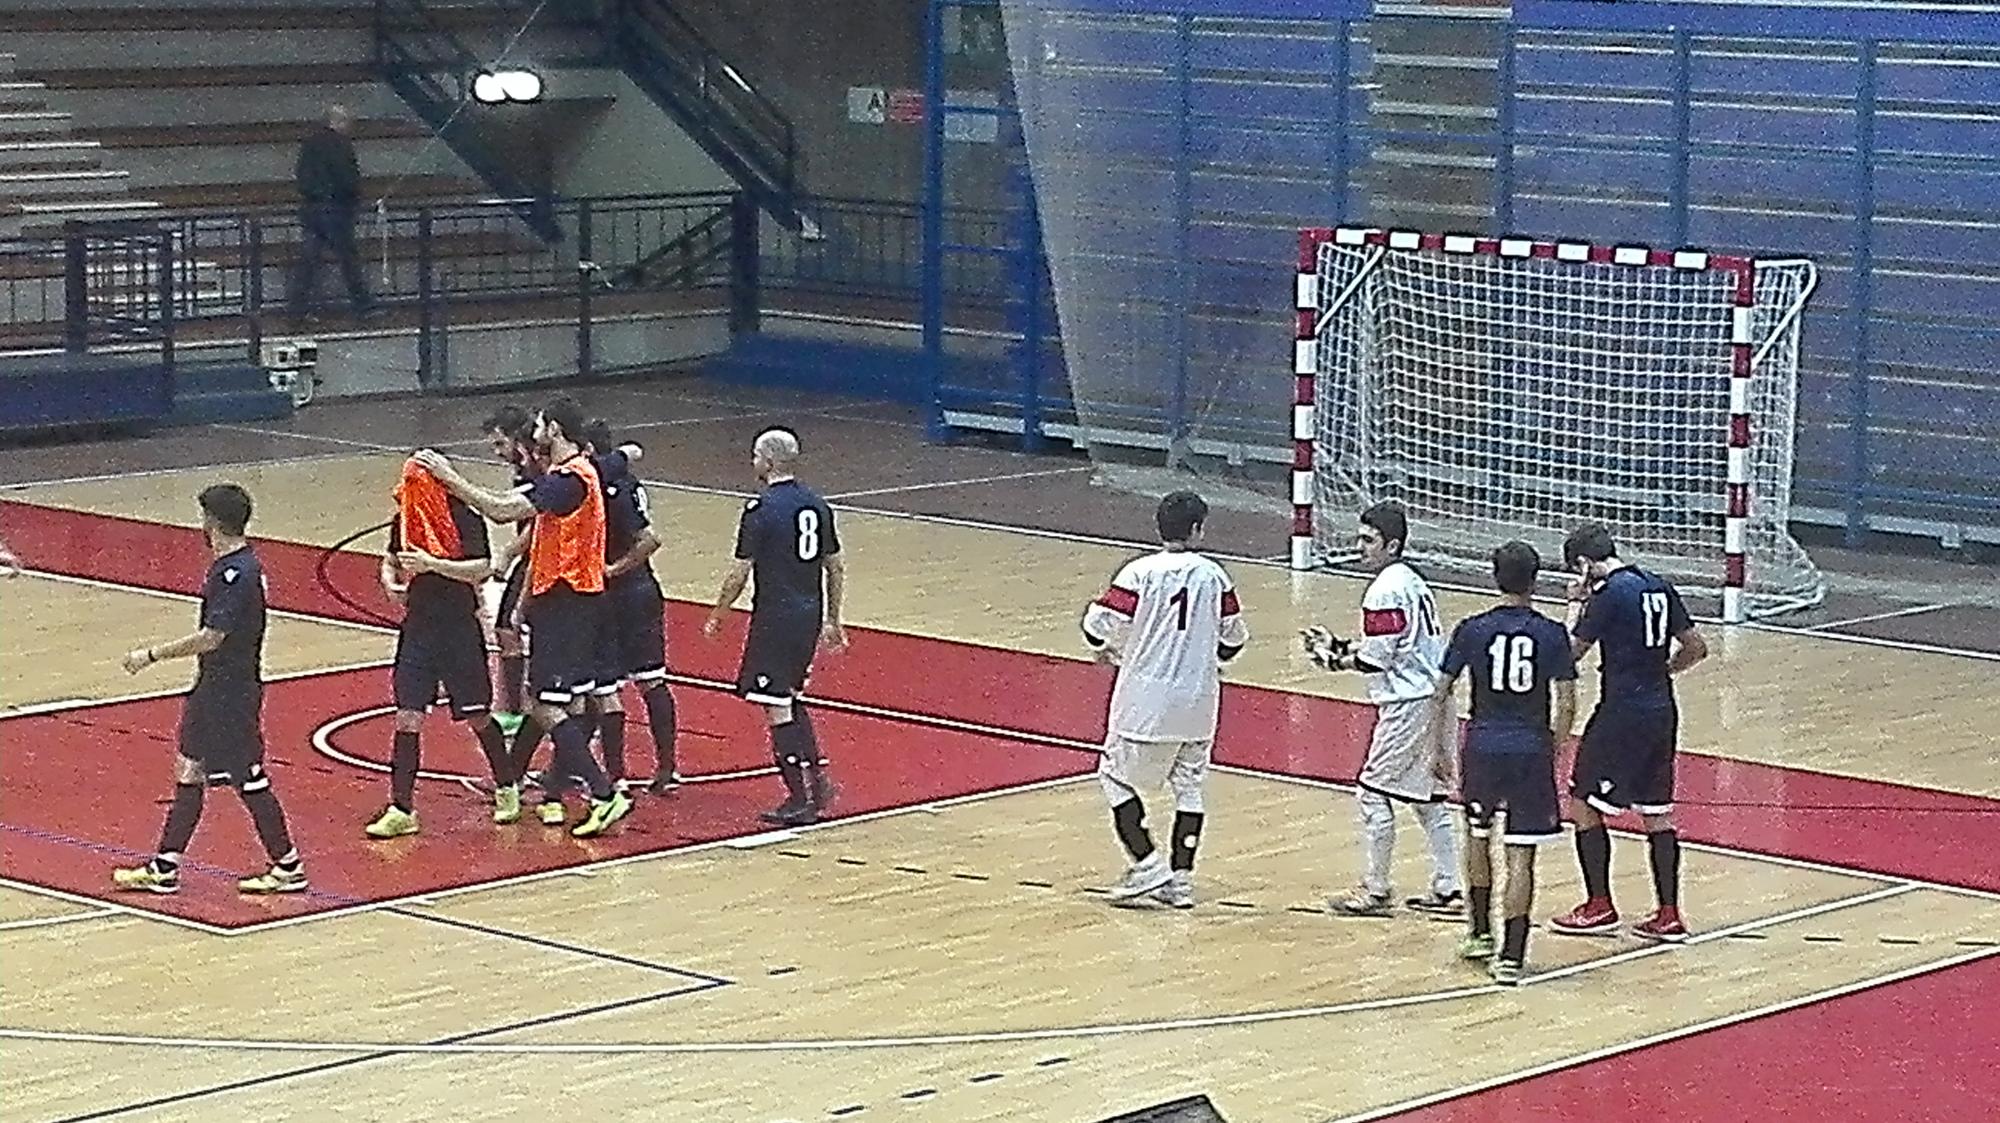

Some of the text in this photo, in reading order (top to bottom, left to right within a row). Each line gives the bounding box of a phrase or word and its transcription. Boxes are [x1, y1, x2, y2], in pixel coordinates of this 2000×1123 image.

[799, 510, 818, 560] 8
[1170, 586, 1188, 631] 1
[1642, 592, 1668, 647] 17
[1488, 634, 1534, 692] 16
